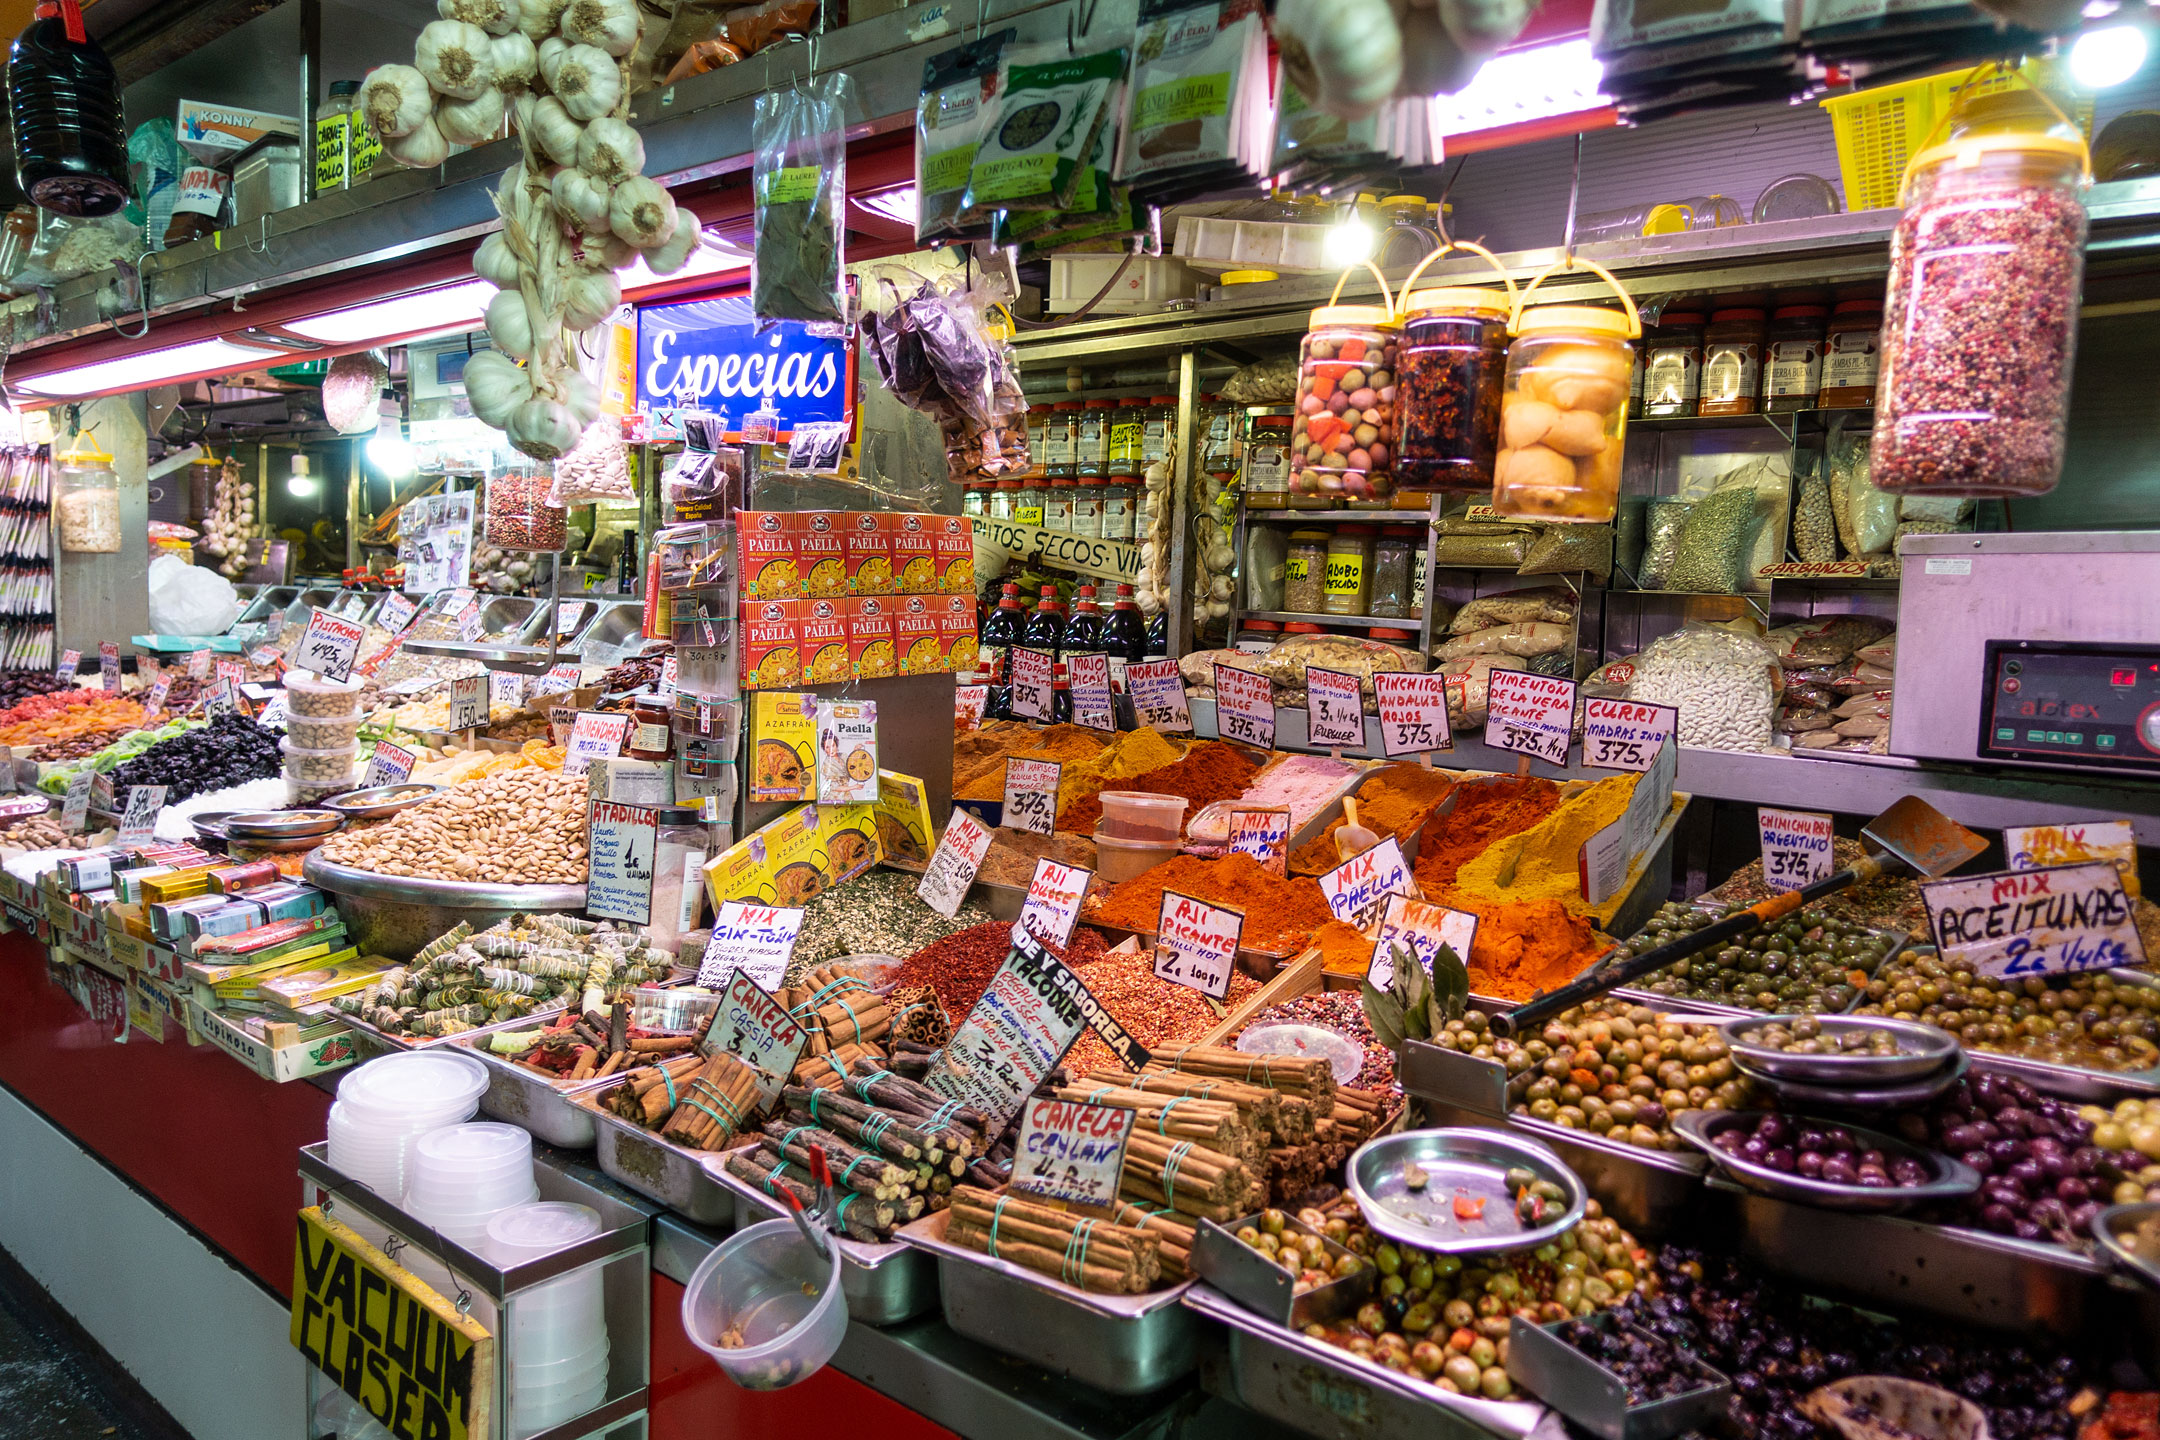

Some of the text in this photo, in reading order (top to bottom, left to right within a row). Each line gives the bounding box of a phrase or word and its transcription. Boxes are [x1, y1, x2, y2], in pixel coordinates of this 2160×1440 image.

[198, 110, 254, 128] KONNY
[317, 163, 344, 183] POLLO
[983, 157, 1044, 176] OREGANO
[645, 329, 838, 398] Especias
[749, 539, 793, 552] PAELLA
[801, 538, 842, 551] PAELLA
[849, 537, 888, 550] PAELLA
[895, 537, 932, 550] PAELLA
[938, 539, 971, 552] PAELLA
[1326, 563, 1359, 579] ADOBO
[1759, 562, 1870, 575] GARBANZOS
[310, 612, 361, 641] PISTACHOS
[804, 624, 845, 638] PAELLA
[852, 622, 891, 635] PAELLA
[899, 618, 936, 632] PAELLA
[941, 617, 975, 630] PAELLA
[311, 630, 352, 647] GIGANTES
[751, 628, 795, 641] PAELLA
[1012, 649, 1049, 666] CALLOS
[1074, 657, 1105, 672] MOJO
[1128, 661, 1179, 681] MORUNAS
[1217, 681, 1273, 705] DE LA VERA
[1491, 671, 1570, 696] PIMENTÓN
[1219, 695, 1253, 712] DULCE
[1379, 694, 1440, 708] ANDALUZ
[1490, 688, 1570, 711] DE LA VERA
[2020, 697, 2100, 719] alotex
[1383, 710, 1422, 723] ROJOS
[1489, 702, 1548, 721] PICANTE
[1588, 701, 1658, 725] CURRY
[574, 716, 626, 743] ALMENDRAS
[765, 719, 811, 728] AZAFRÁN
[837, 723, 872, 733] Paella
[1587, 723, 1637, 740] MADRAS
[593, 802, 657, 828] ATADILLOS
[1242, 813, 1273, 829] MIX
[957, 818, 983, 844] MIX
[1760, 816, 1832, 842] CHIMICHURRY
[776, 829, 817, 860] AZAFRÁN
[1763, 830, 1828, 852] ARGENTINO
[2033, 828, 2086, 854] MIX
[626, 870, 651, 880] UNIDAD
[724, 862, 765, 895] AZAFRÁN
[1336, 852, 1375, 892] MIX
[1331, 865, 1404, 918] PAELLA
[1992, 873, 2052, 904] MIX
[736, 906, 779, 926] MIX
[1402, 901, 1447, 932] MIX
[1938, 889, 2128, 950] ACEITUNAS
[1162, 916, 1237, 953] PICANTE
[1040, 952, 1057, 972] Y
[1196, 948, 1223, 961] HOT
[998, 970, 1043, 1010] REGALIZ
[732, 979, 798, 1047] CANELA
[202, 1010, 256, 1059] Espinosa
[729, 1007, 774, 1053] CASSIA
[996, 1062, 1023, 1095] Pack
[1032, 1100, 1125, 1138] CANELA
[298, 1215, 474, 1430] VACUUM
